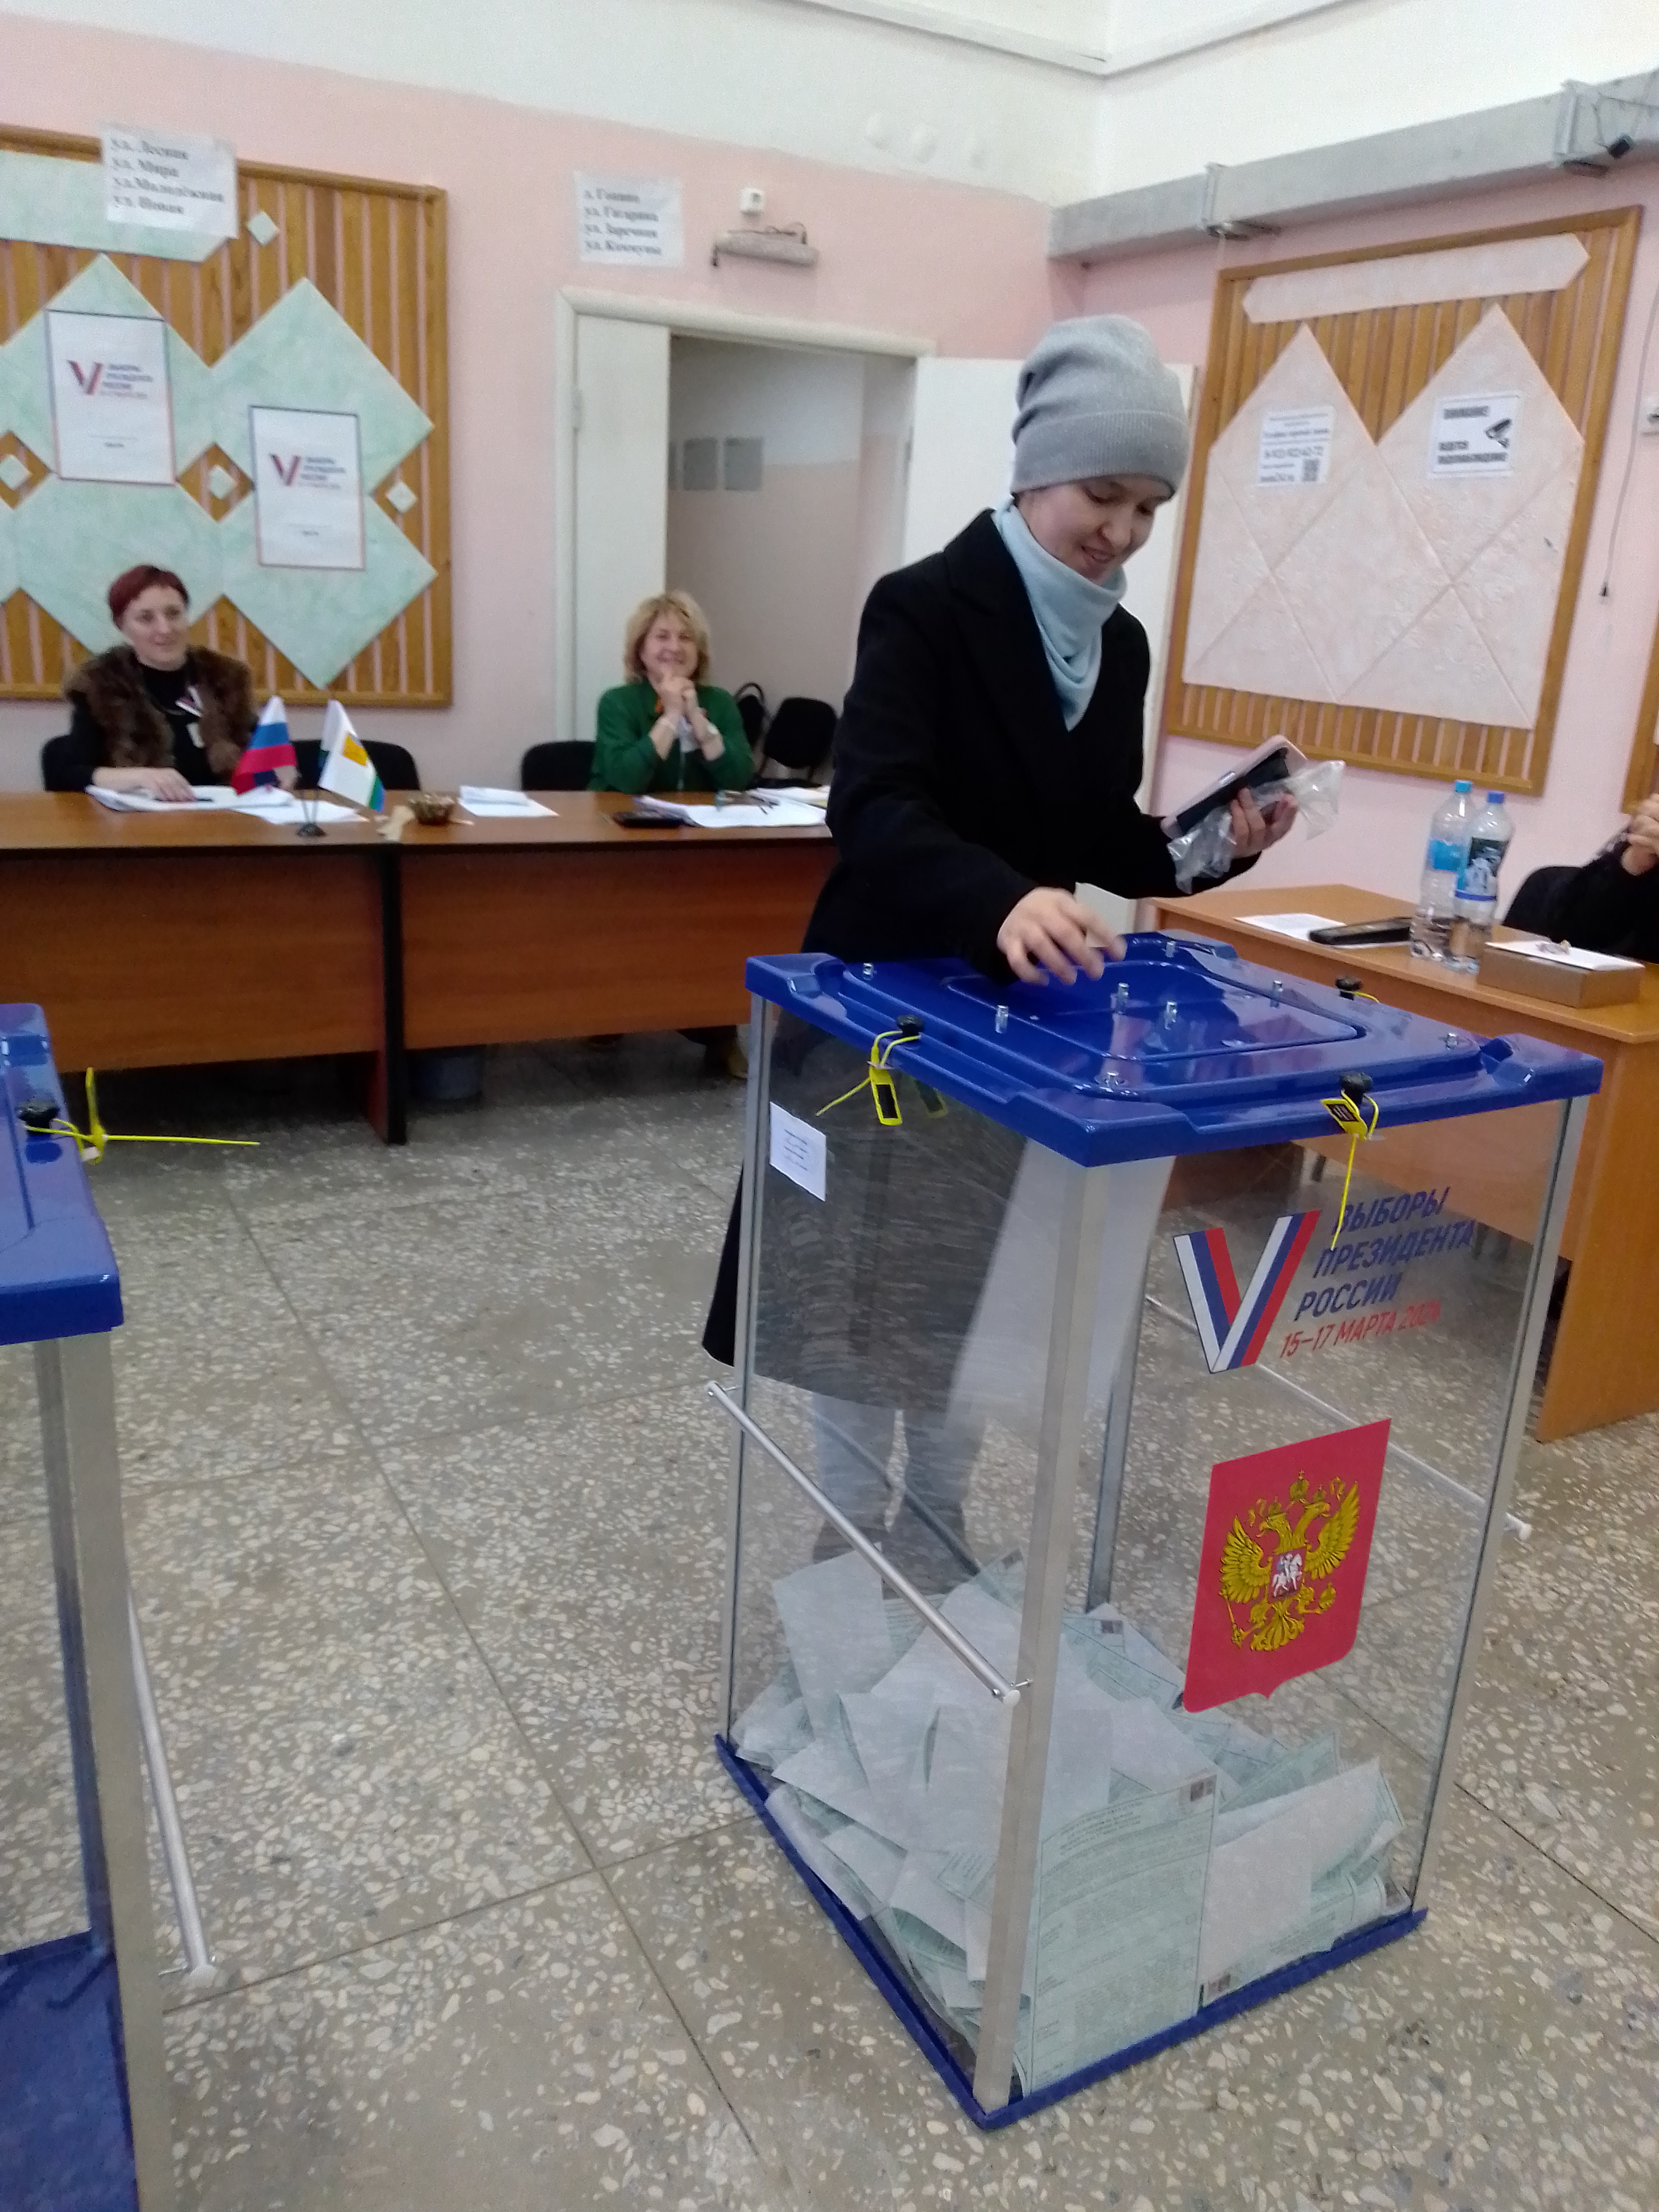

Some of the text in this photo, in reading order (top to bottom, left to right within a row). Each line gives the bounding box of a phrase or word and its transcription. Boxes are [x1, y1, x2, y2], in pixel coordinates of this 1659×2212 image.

[1332, 1186, 1451, 1237] ВЫБОРЫ
[1312, 1220, 1476, 1278] ПРЕЗИДЕНТА
[1294, 1271, 1403, 1322] РОССИИ
[1333, 1311, 1397, 1347] МАРТА
